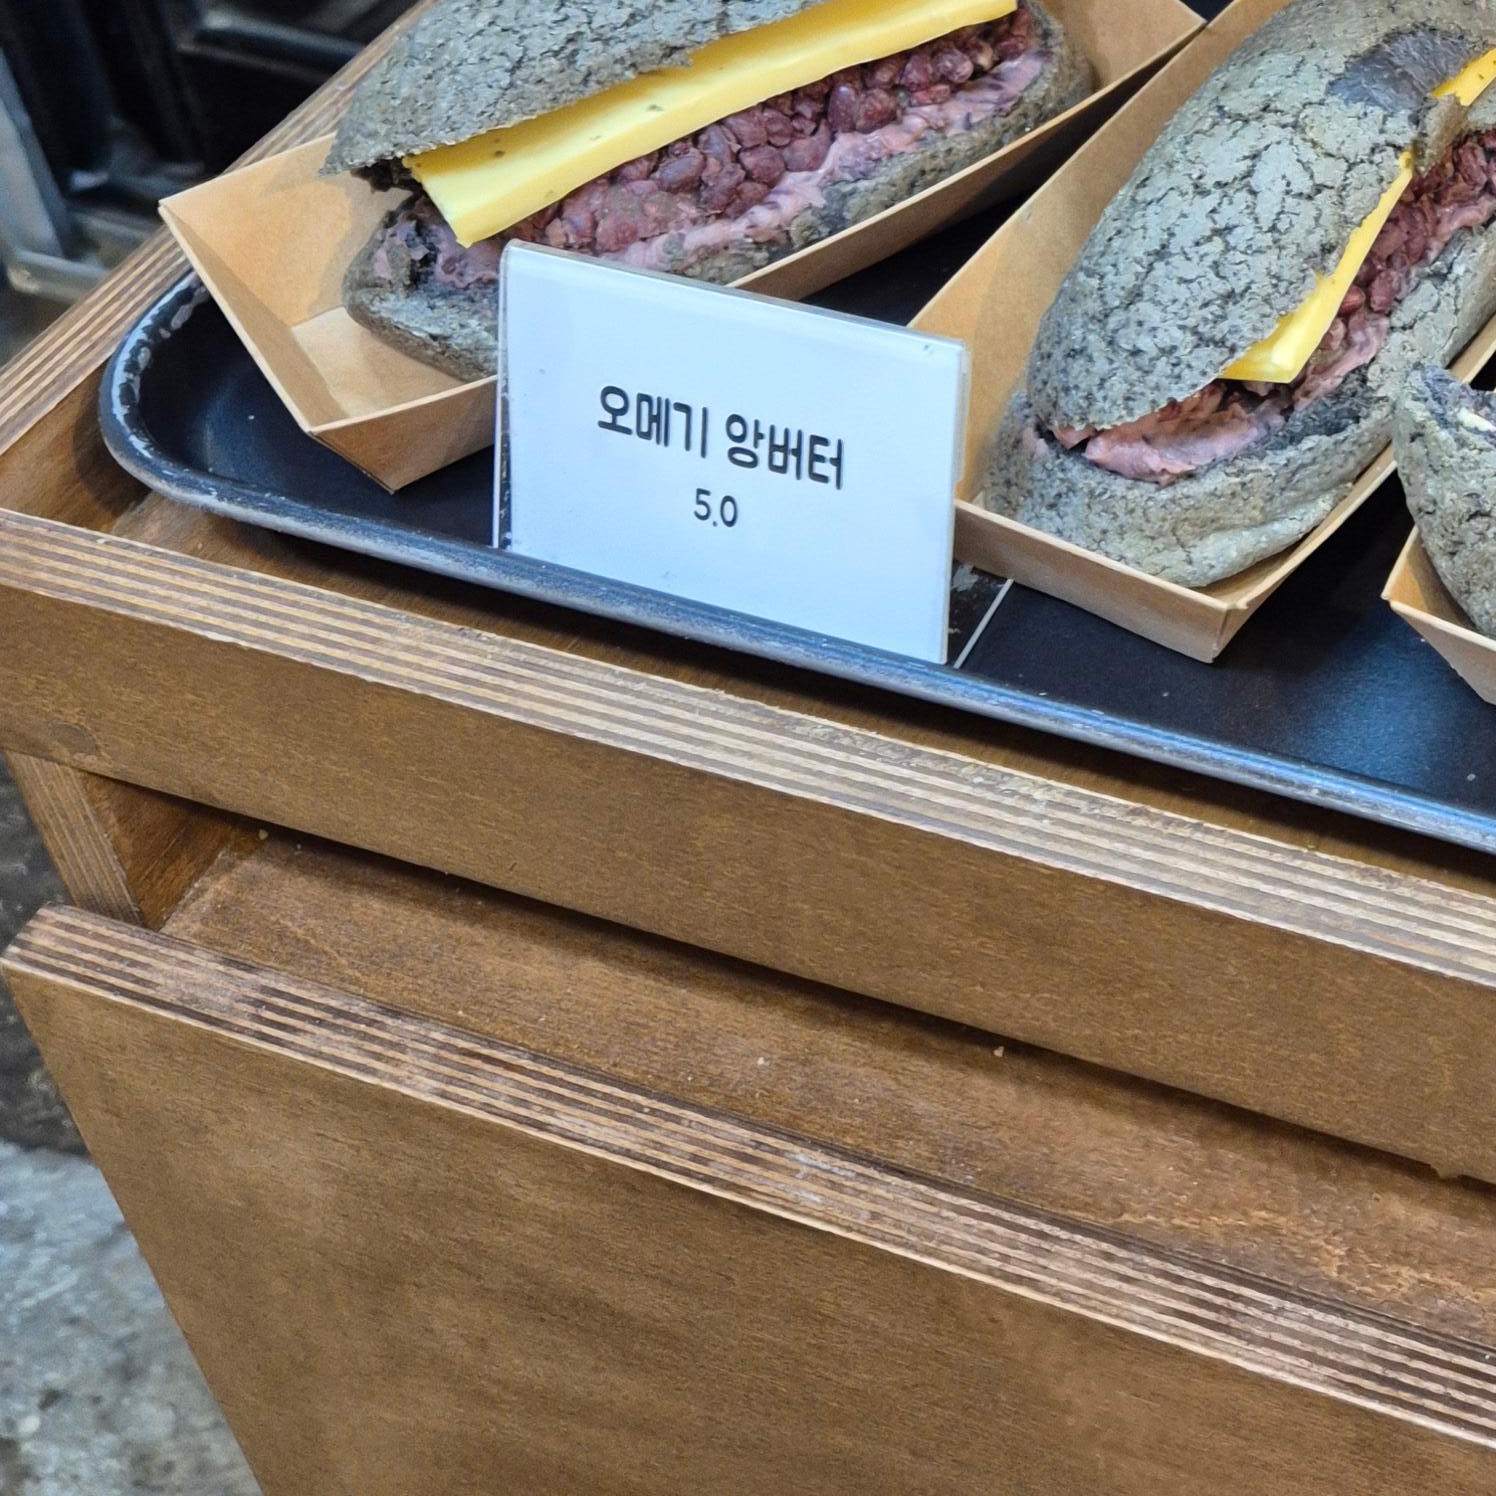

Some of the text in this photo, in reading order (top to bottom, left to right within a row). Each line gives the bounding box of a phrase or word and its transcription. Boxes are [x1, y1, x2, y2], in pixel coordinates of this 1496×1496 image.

[597, 385, 844, 490] 오메기 앙버터
[693, 488, 739, 528] 5.0
